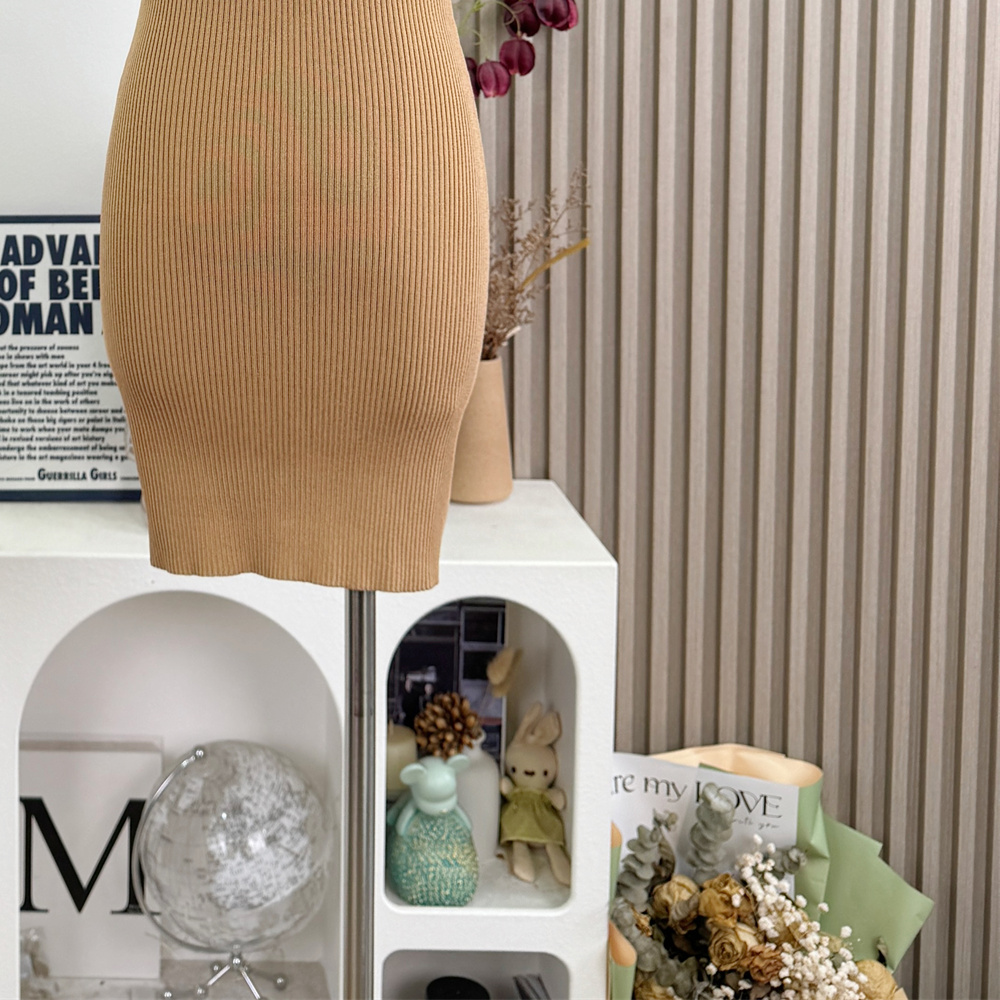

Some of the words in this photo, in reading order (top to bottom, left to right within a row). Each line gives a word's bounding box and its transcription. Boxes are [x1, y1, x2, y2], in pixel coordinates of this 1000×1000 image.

[611, 774, 636, 795] re
[643, 776, 688, 803] my
[19, 796, 161, 915] M
